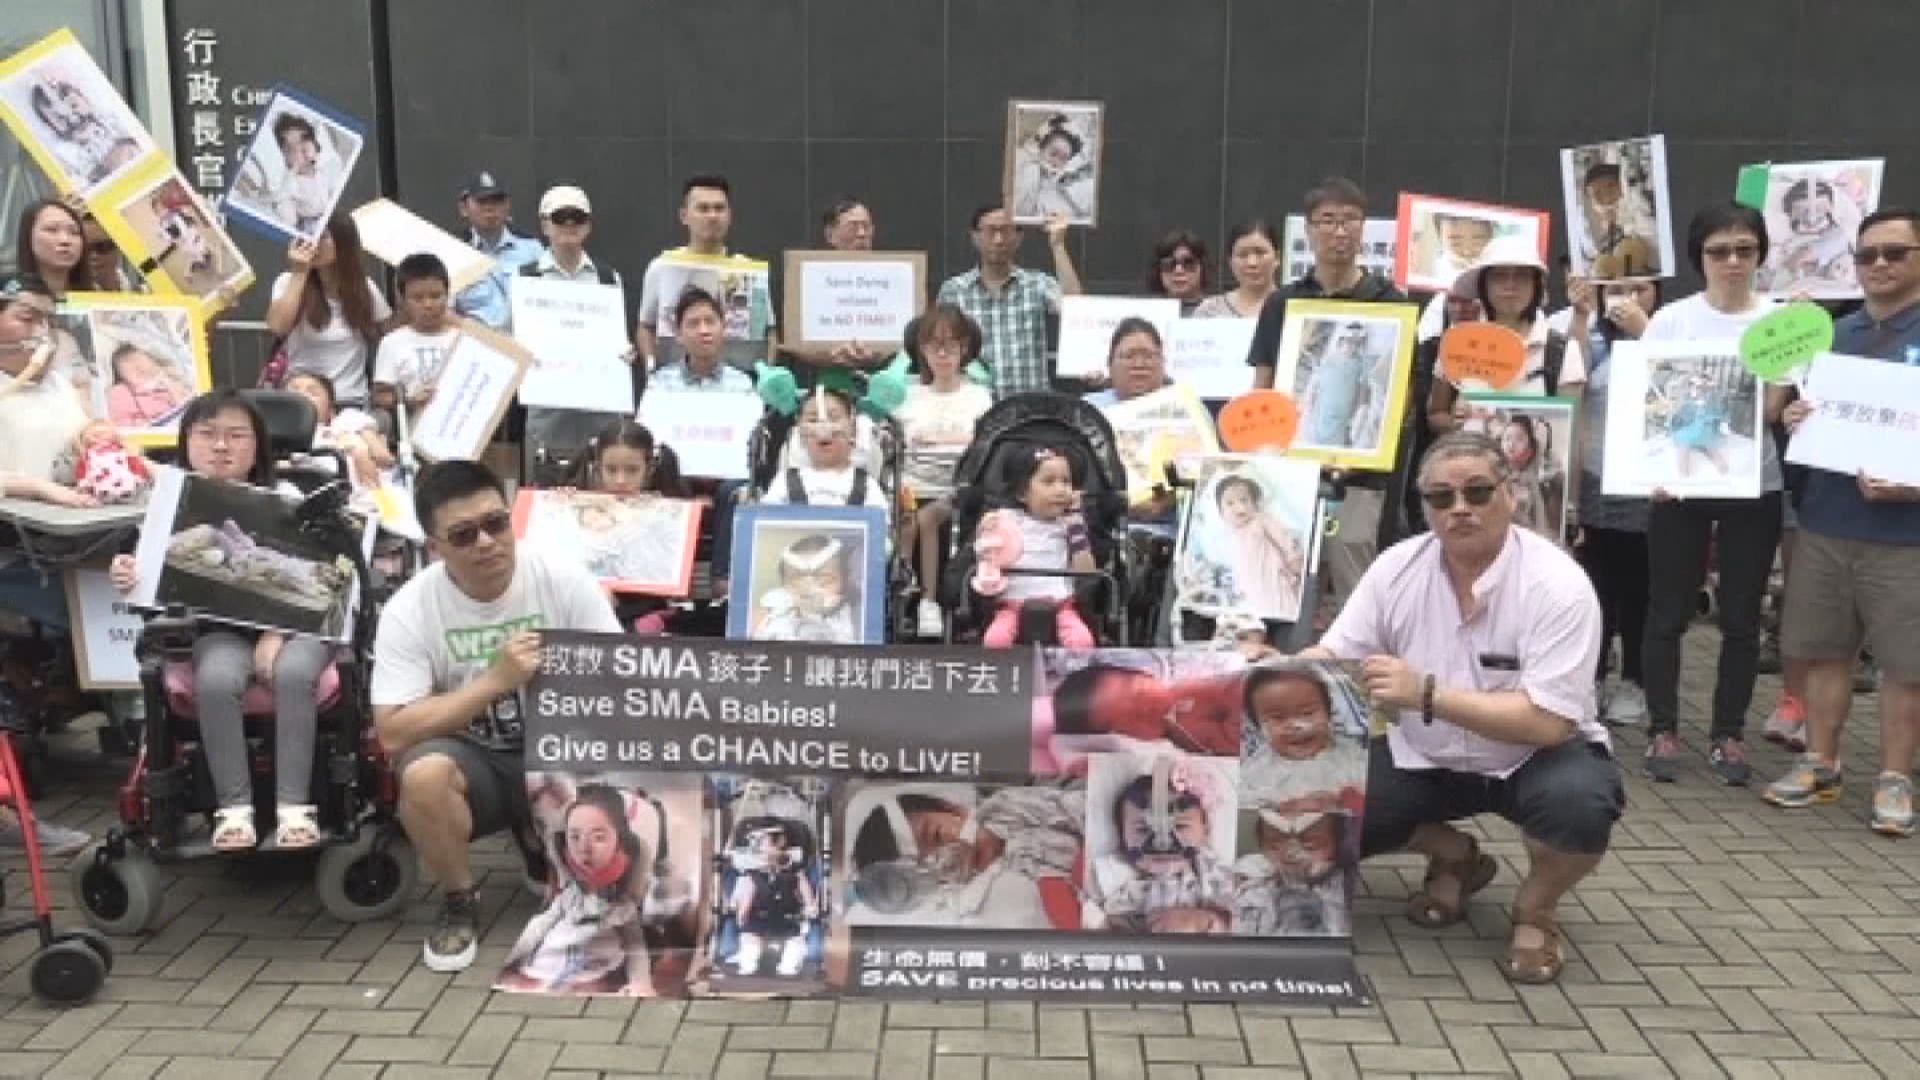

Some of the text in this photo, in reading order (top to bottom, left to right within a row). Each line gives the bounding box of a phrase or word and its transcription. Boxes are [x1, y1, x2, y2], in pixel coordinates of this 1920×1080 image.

[612, 645, 702, 679] SMA
[538, 687, 837, 728] Save SMA Babies!
[537, 733, 982, 776] Give us a CHANCE to LIVE!
[861, 969, 960, 987] SAVE
[967, 976, 1105, 990] precious
[1112, 976, 1184, 993] lives
[1192, 976, 1220, 993] in
[1228, 980, 1268, 993] no
